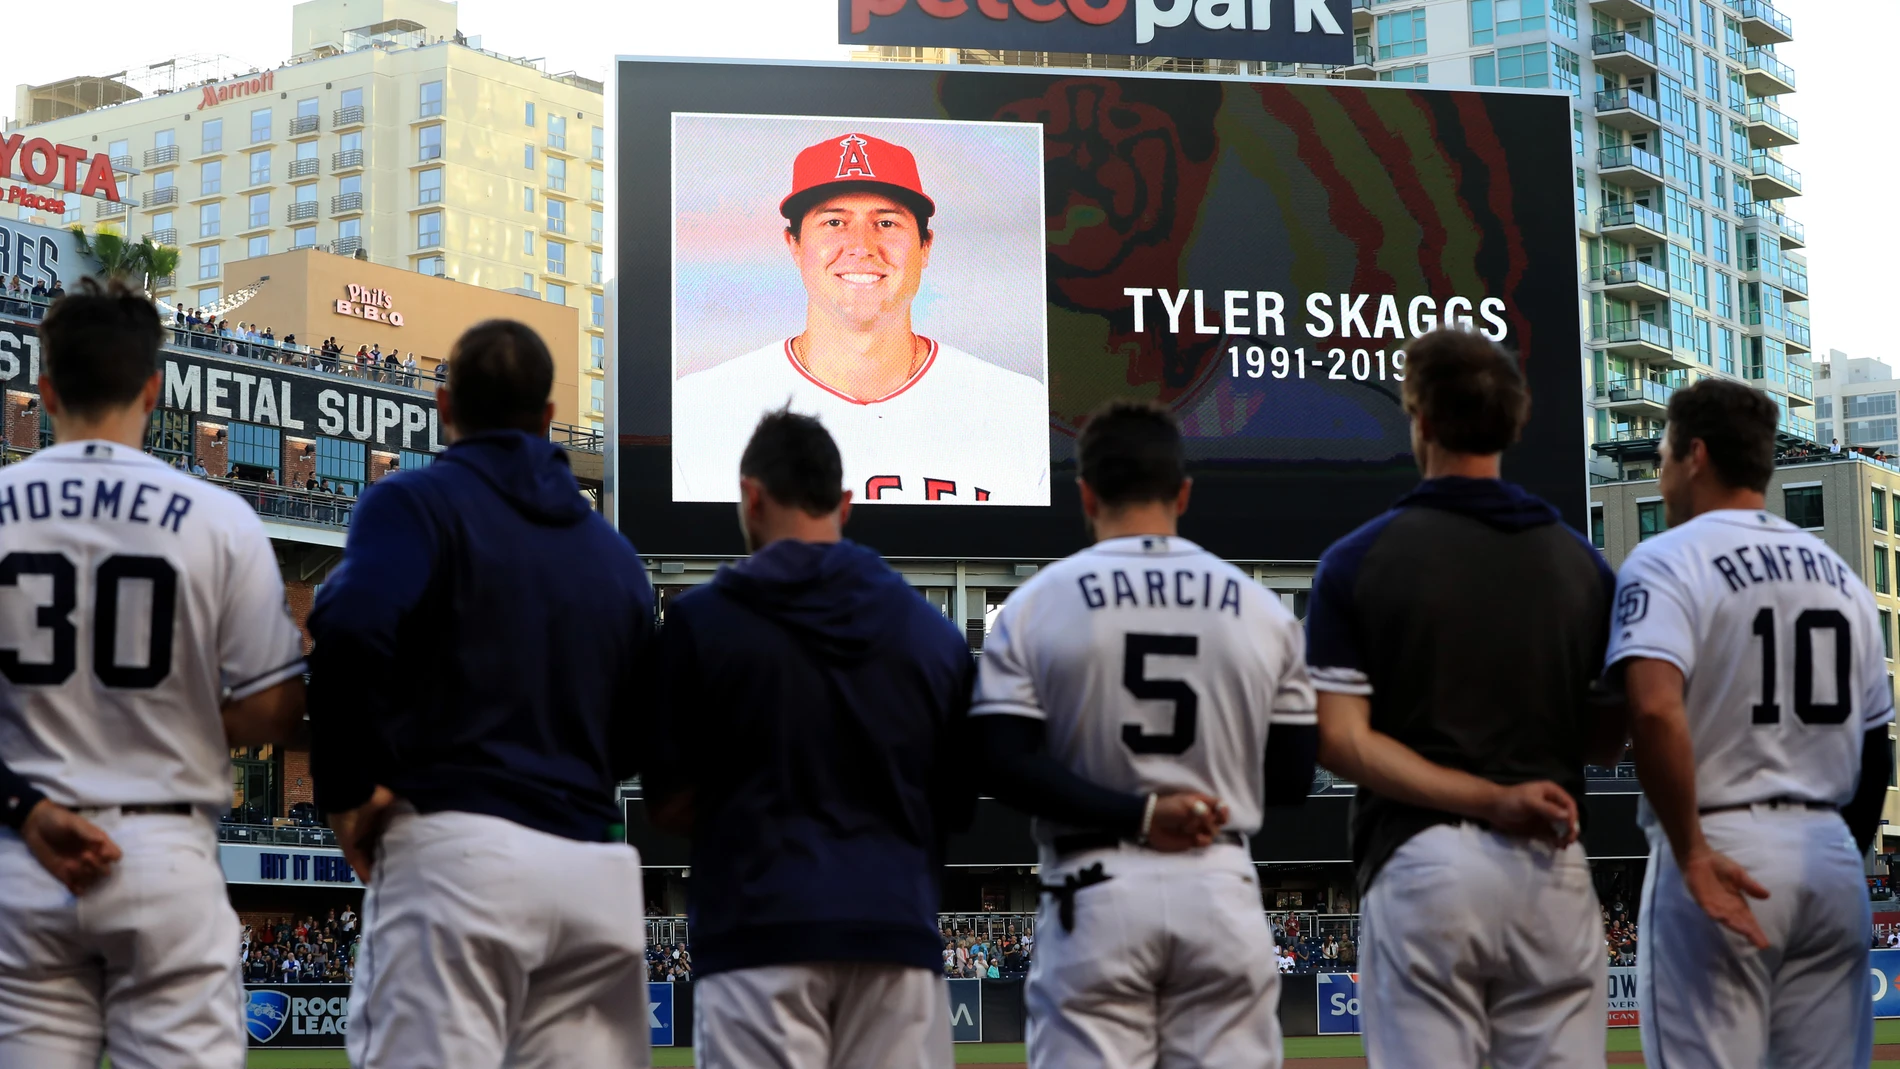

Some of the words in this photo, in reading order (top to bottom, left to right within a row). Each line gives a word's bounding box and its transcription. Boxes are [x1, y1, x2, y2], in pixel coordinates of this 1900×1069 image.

[197, 71, 274, 110] Marriott
[0, 131, 121, 202] YOTA
[8, 185, 66, 214] Places
[347, 283, 393, 310] Phil's
[1123, 287, 1286, 337] TYLER
[1305, 292, 1508, 342] SKAGGS
[1227, 345, 1407, 382] 1991-2019
[165, 360, 304, 430] METAL
[0, 479, 192, 533] HOSMER
[0, 551, 178, 688] 30
[1078, 569, 1241, 619] GARCIA
[1751, 607, 1852, 725] 10
[1121, 632, 1198, 755] 5
[260, 853, 289, 880] HIT
[293, 854, 310, 881] IT
